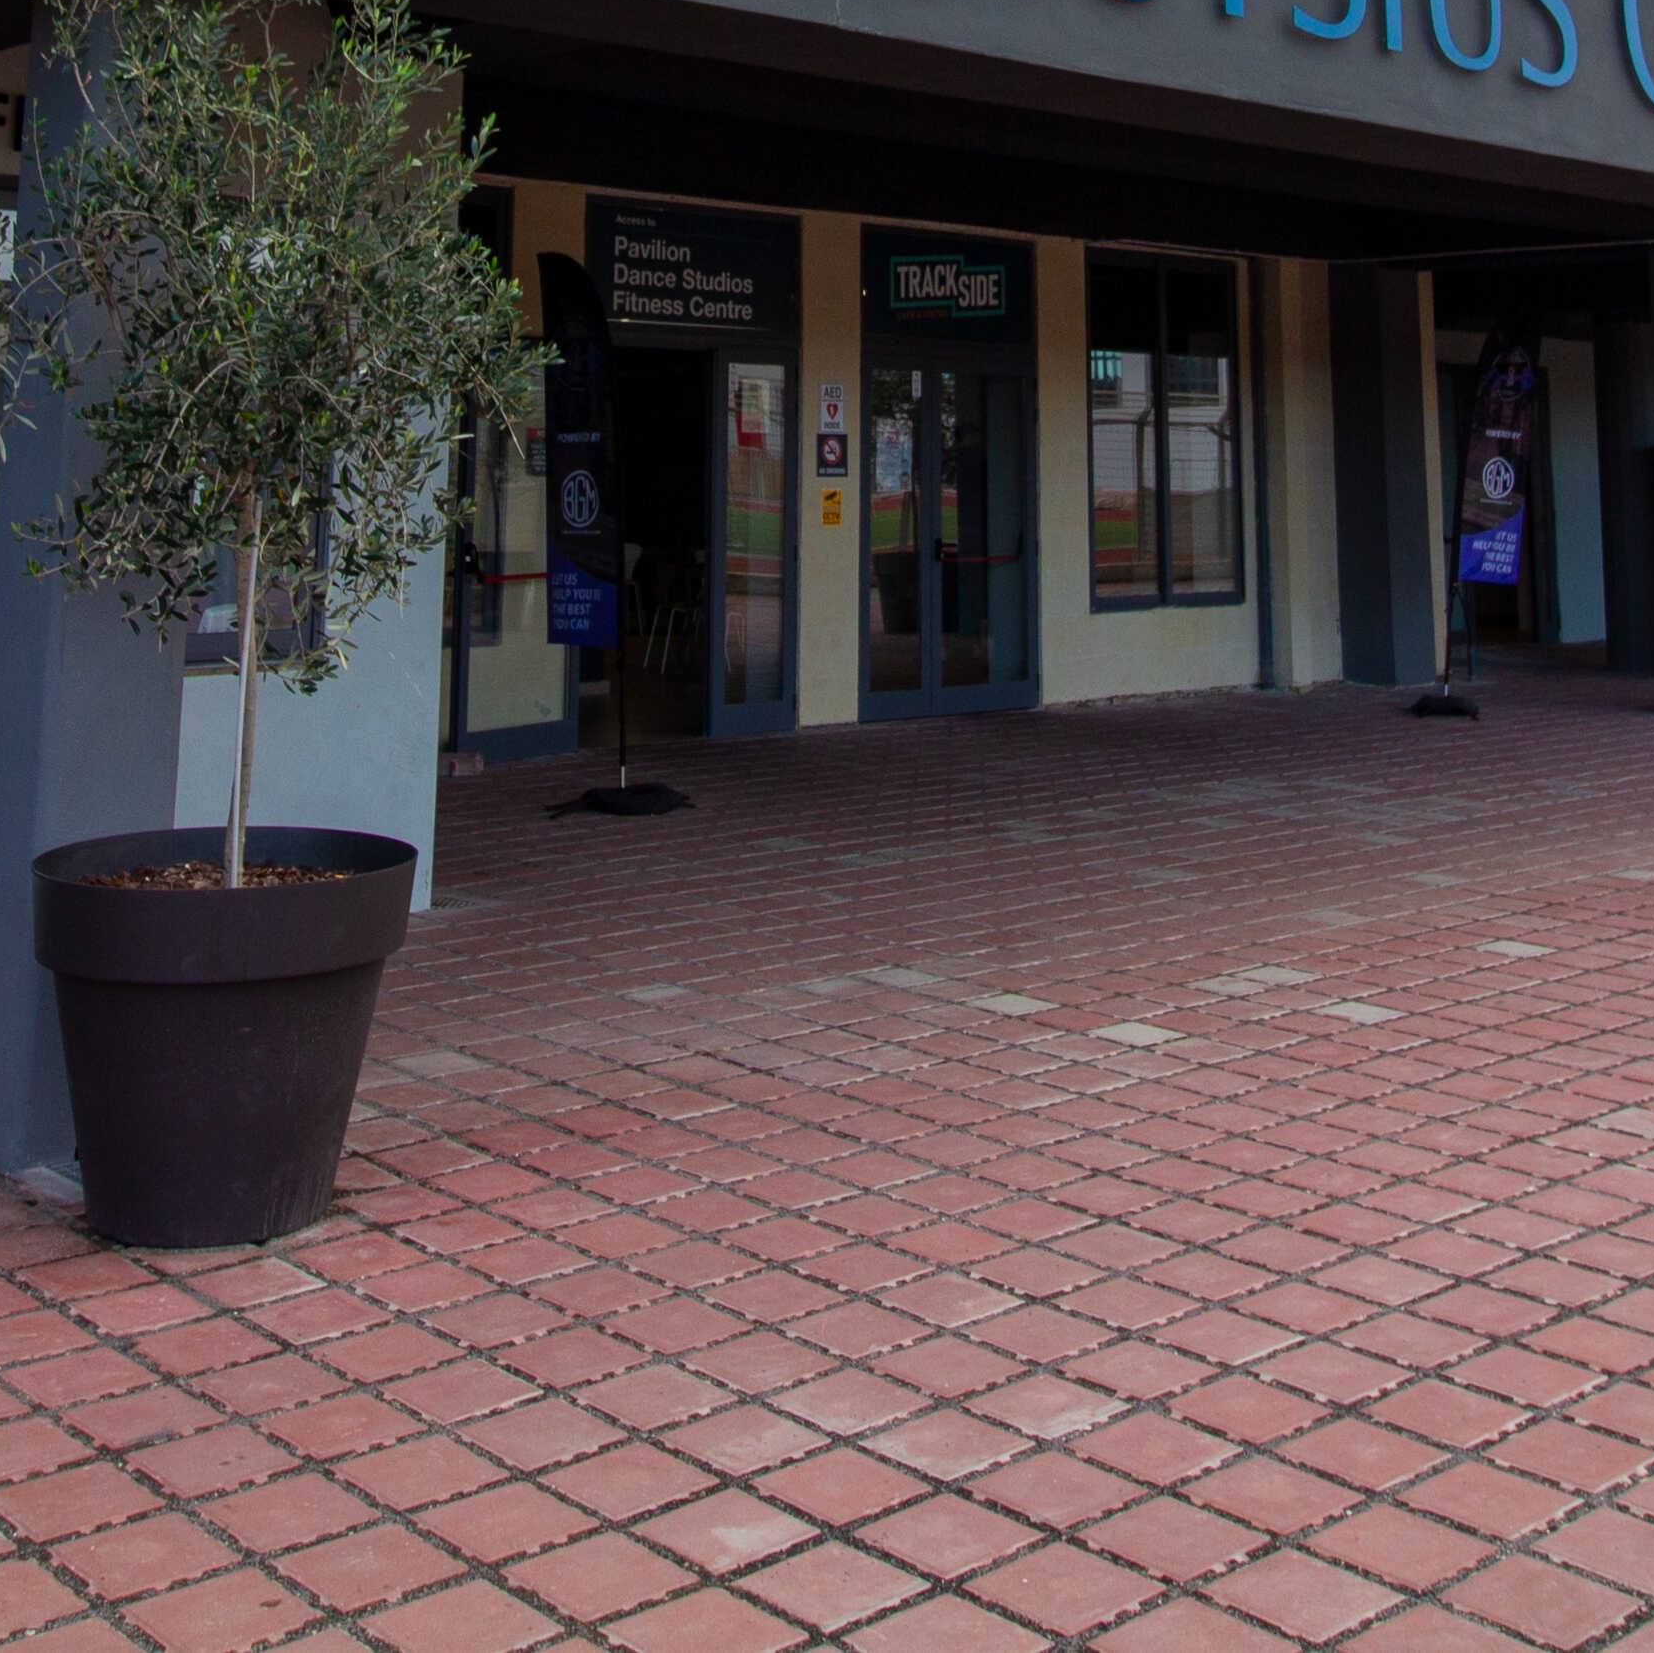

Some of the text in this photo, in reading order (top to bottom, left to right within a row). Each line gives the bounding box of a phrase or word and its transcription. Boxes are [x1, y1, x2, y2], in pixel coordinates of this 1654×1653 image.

[614, 235, 691, 263] Pavilion
[613, 262, 754, 294] Dance Studios
[612, 290, 753, 320] Fitness Centre
